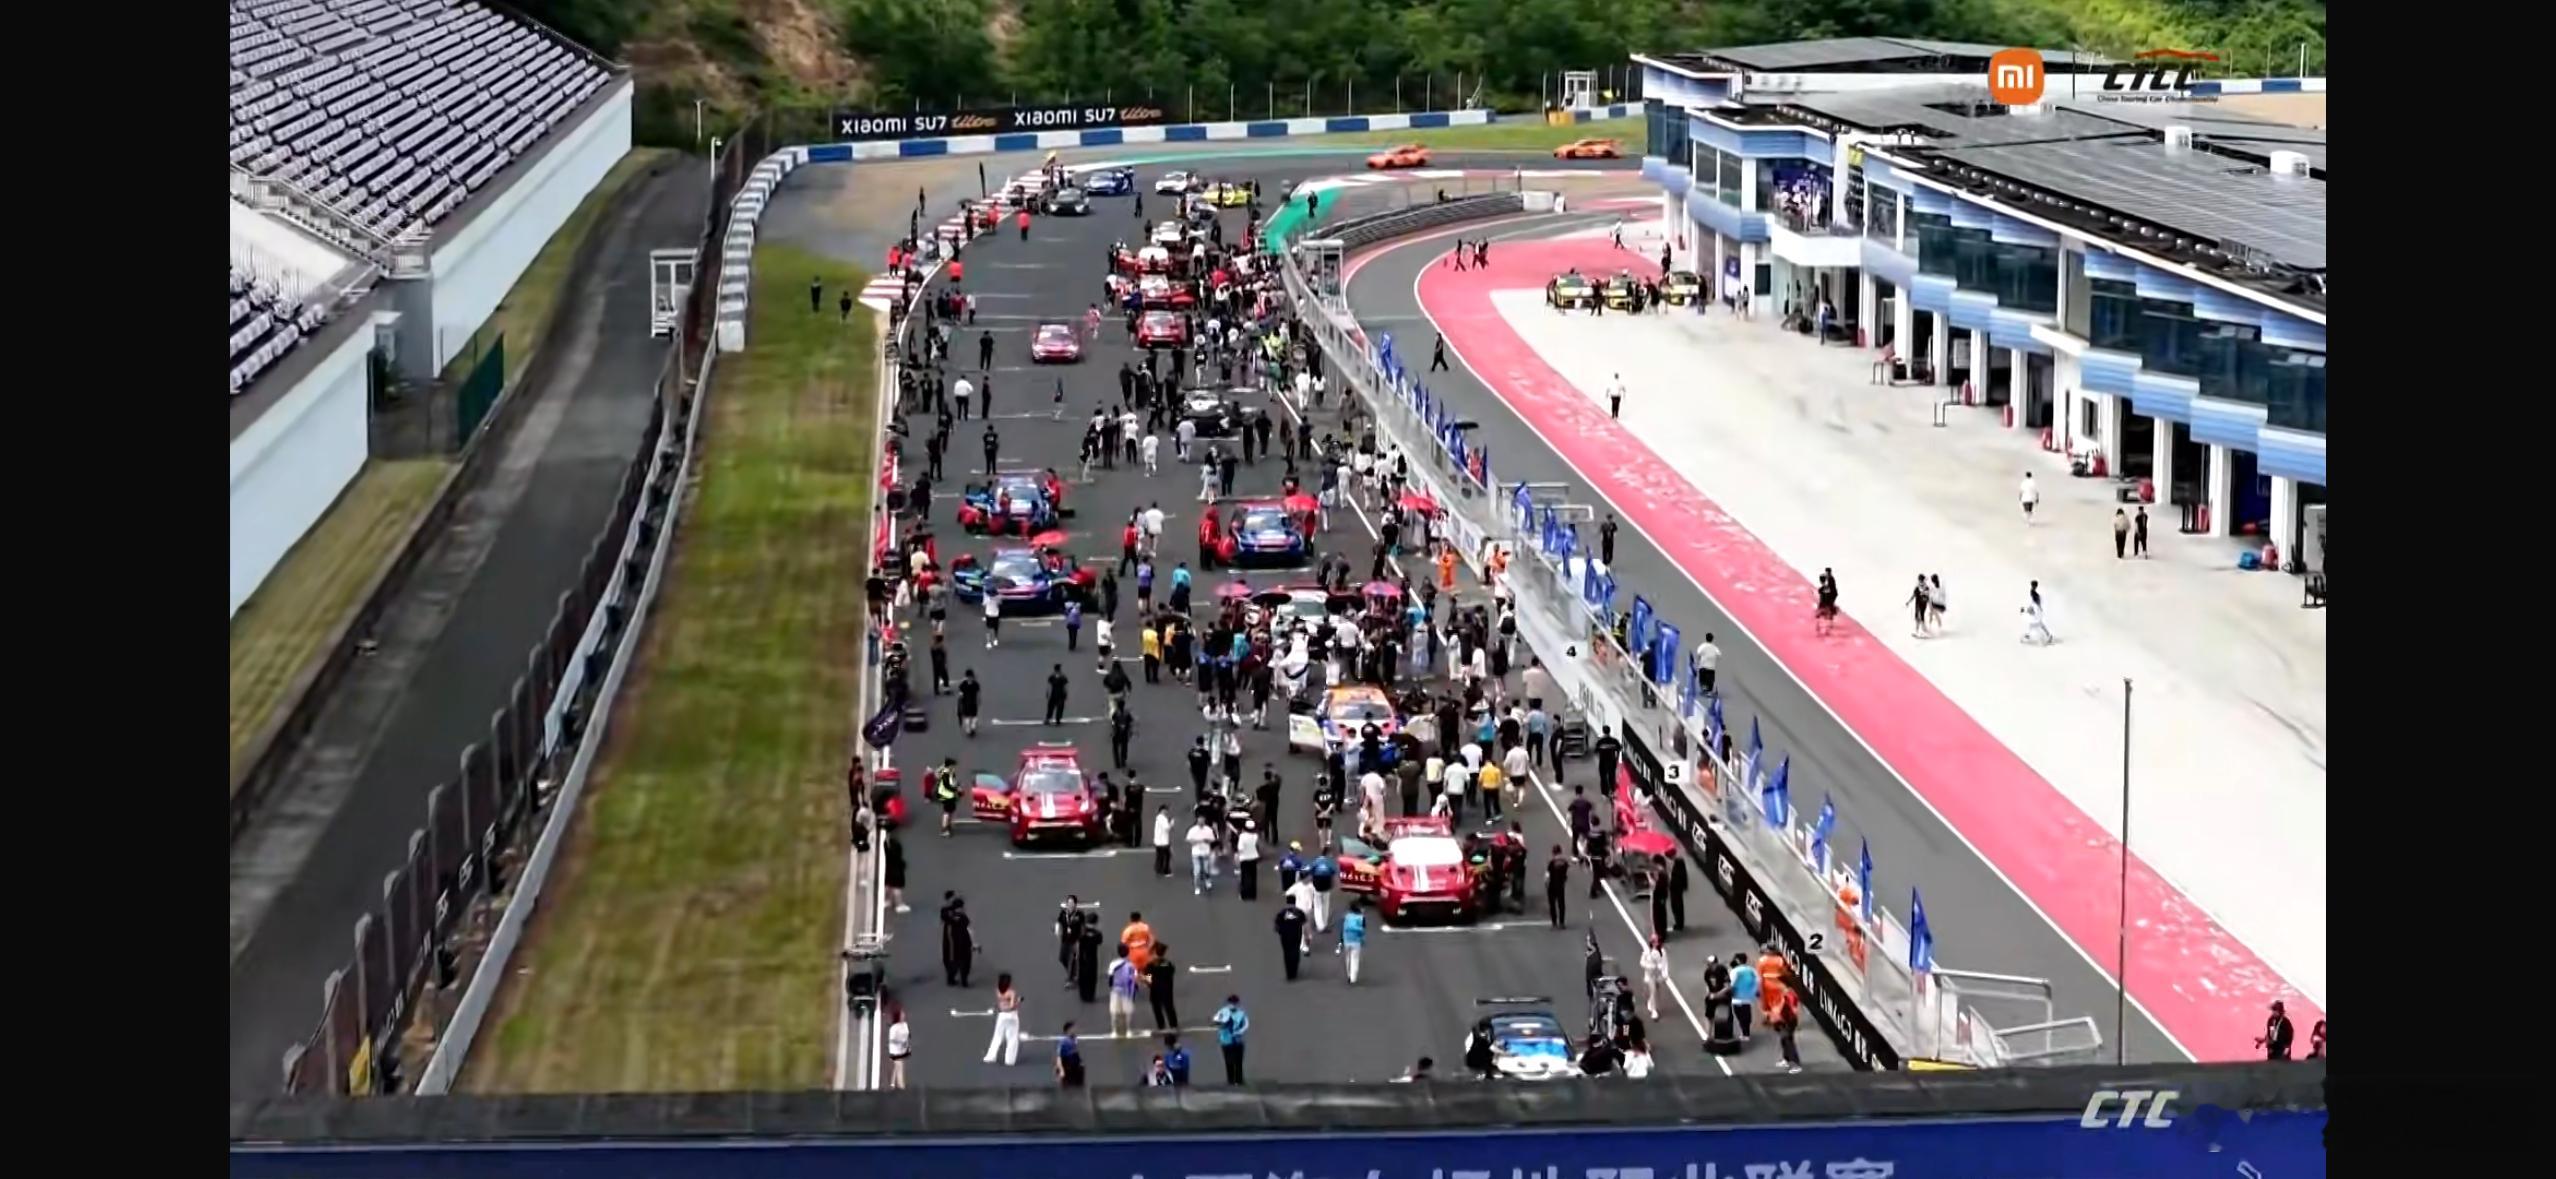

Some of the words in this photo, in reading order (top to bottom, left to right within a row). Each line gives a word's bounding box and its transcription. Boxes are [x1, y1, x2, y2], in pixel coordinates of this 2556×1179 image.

[914, 115, 948, 131] SU7
[1085, 107, 1116, 123] SU7
[1566, 646, 1577, 657] 4
[1668, 764, 1680, 780] 3
[1809, 933, 1824, 950] 2
